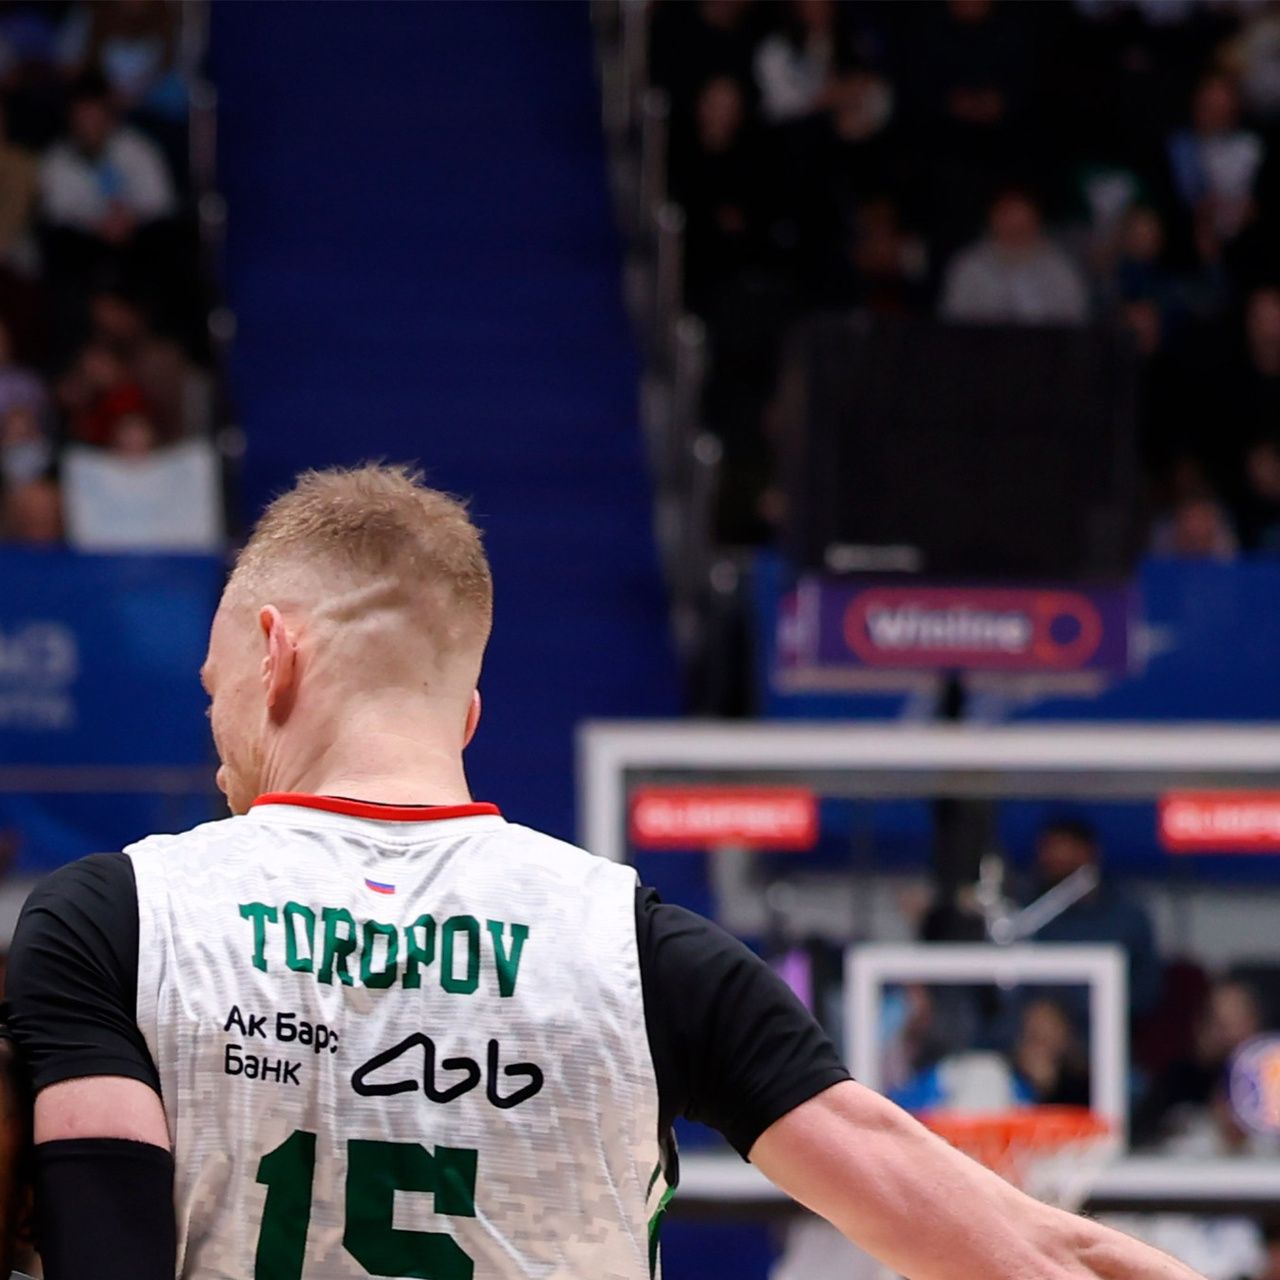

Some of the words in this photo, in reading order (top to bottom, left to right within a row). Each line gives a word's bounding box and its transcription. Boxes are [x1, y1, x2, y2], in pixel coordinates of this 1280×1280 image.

[238, 900, 530, 998] TOROPOV
[224, 1005, 267, 1039] Ак
[225, 1044, 302, 1086] Банк
